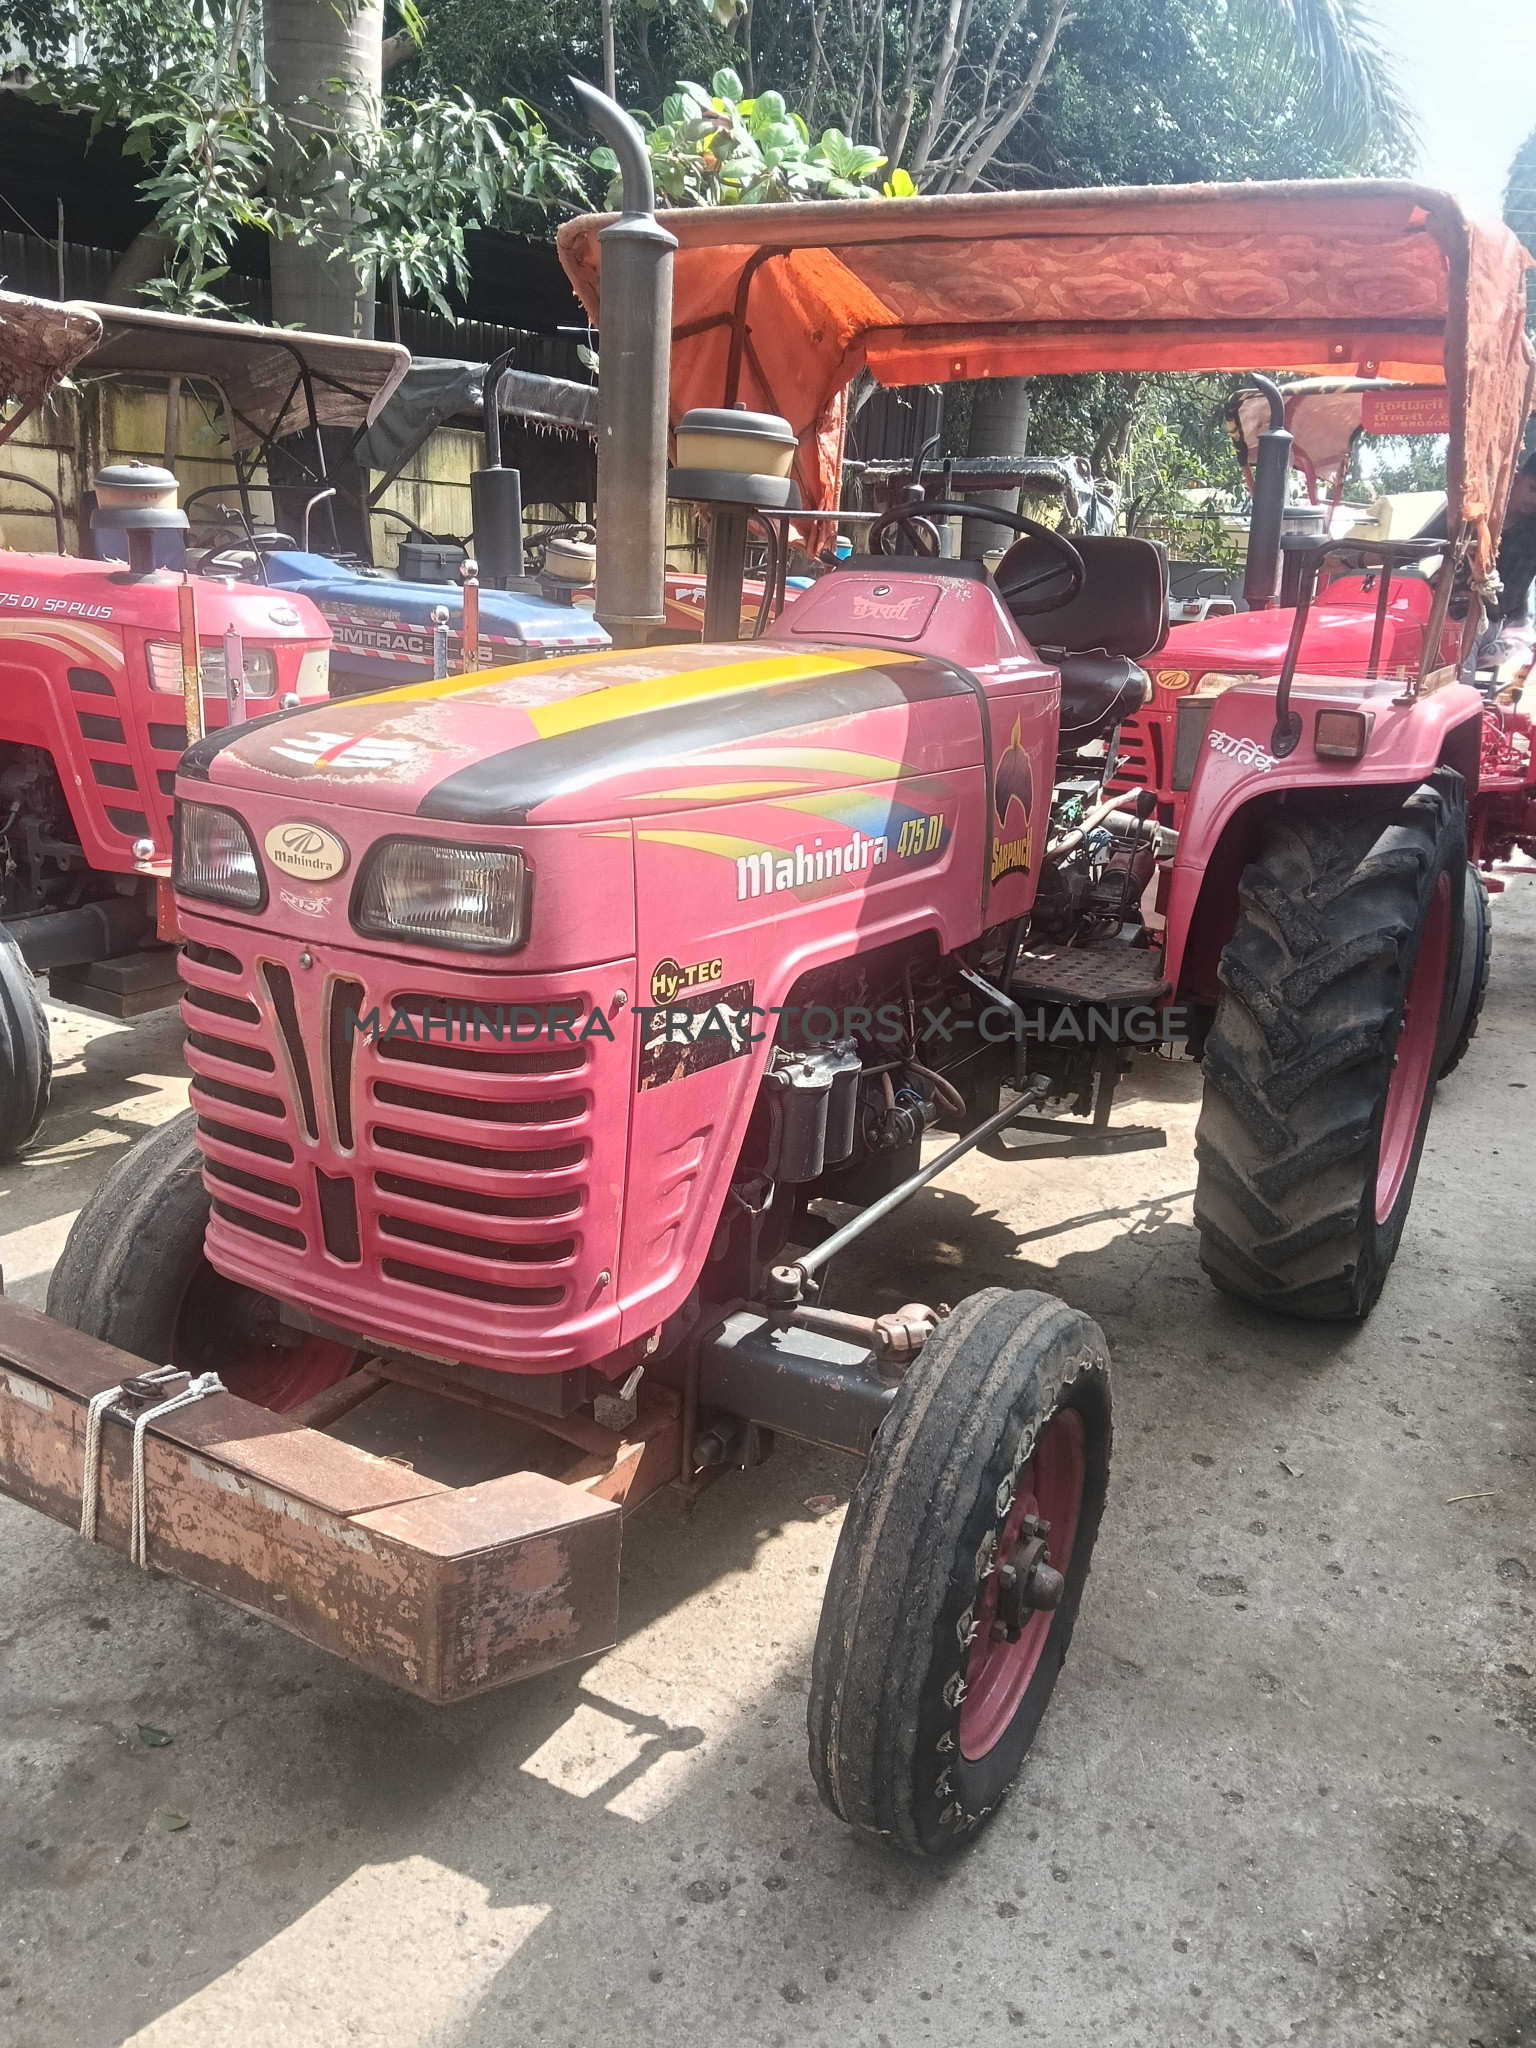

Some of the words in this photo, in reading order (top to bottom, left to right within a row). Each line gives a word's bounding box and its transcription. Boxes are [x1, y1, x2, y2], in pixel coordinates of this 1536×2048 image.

[20, 595, 40, 608] DI
[42, 598, 68, 612] SP
[67, 602, 114, 619] PLUS
[1208, 729, 1280, 773] कार्तिक
[274, 850, 333, 871] Mahindra
[736, 831, 888, 901] Mahindra
[897, 818, 926, 859] 475
[925, 813, 944, 852] DI
[991, 826, 1033, 881] SARPANCH
[652, 959, 722, 997] Hy-TEC
